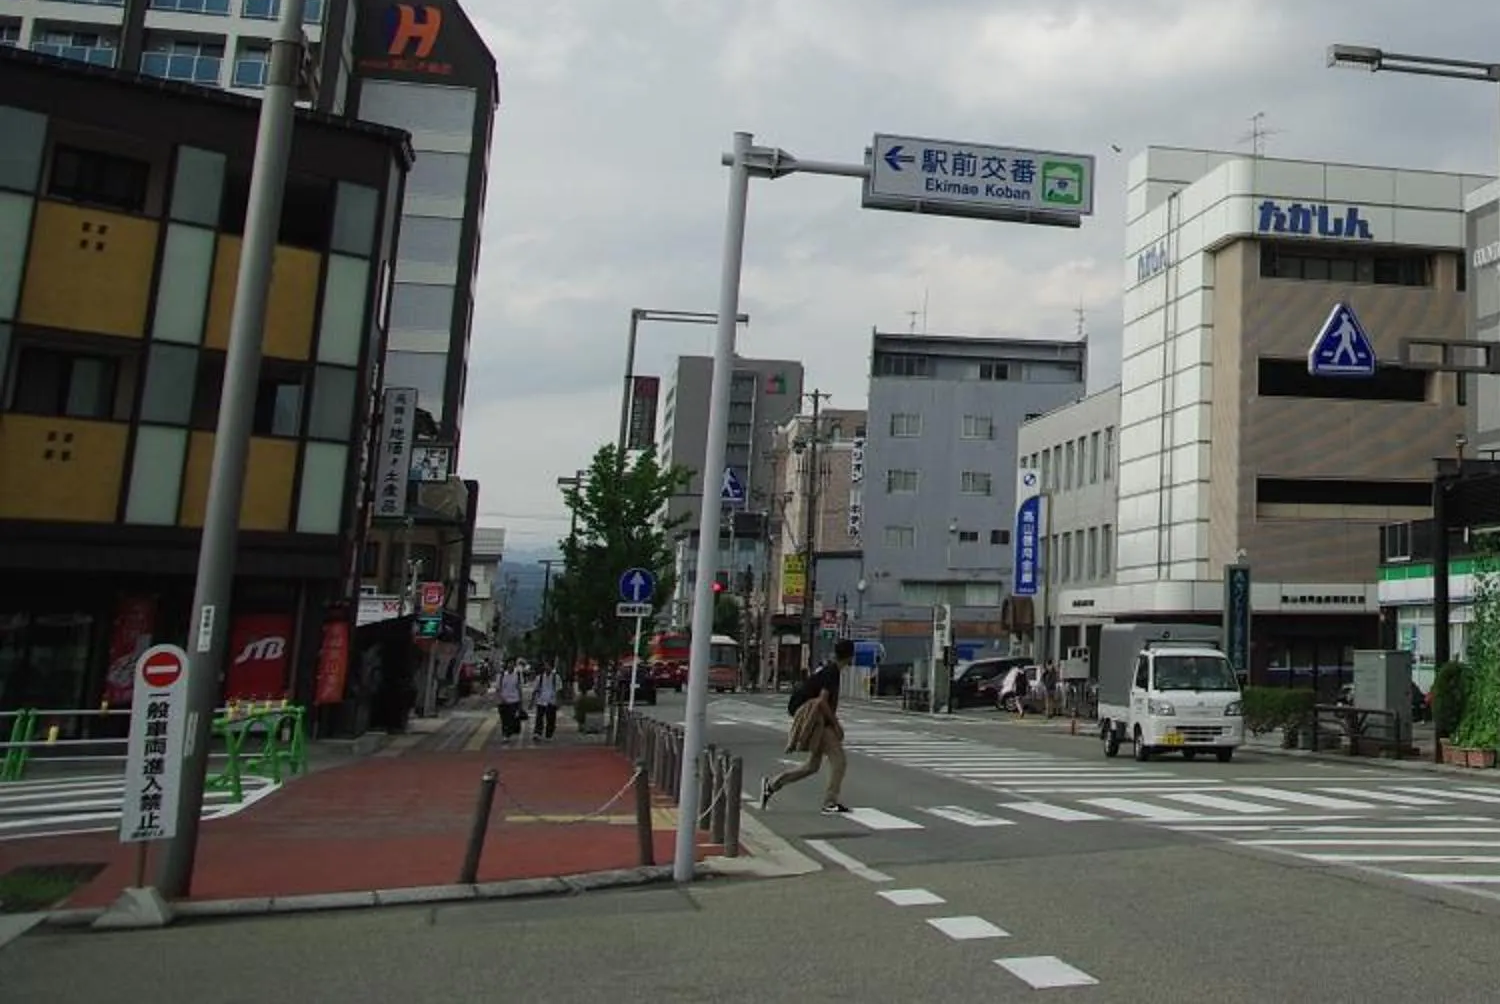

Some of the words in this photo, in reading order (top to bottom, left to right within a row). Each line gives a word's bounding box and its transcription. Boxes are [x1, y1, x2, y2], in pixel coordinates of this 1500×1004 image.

[921, 147, 1036, 185] 駅前交番
[925, 177, 979, 197] Ekimae
[985, 183, 1031, 201] Koban
[1257, 199, 1374, 240] たかしん
[234, 636, 286, 664] JTB
[137, 692, 171, 831] 一般車両進入禁止
